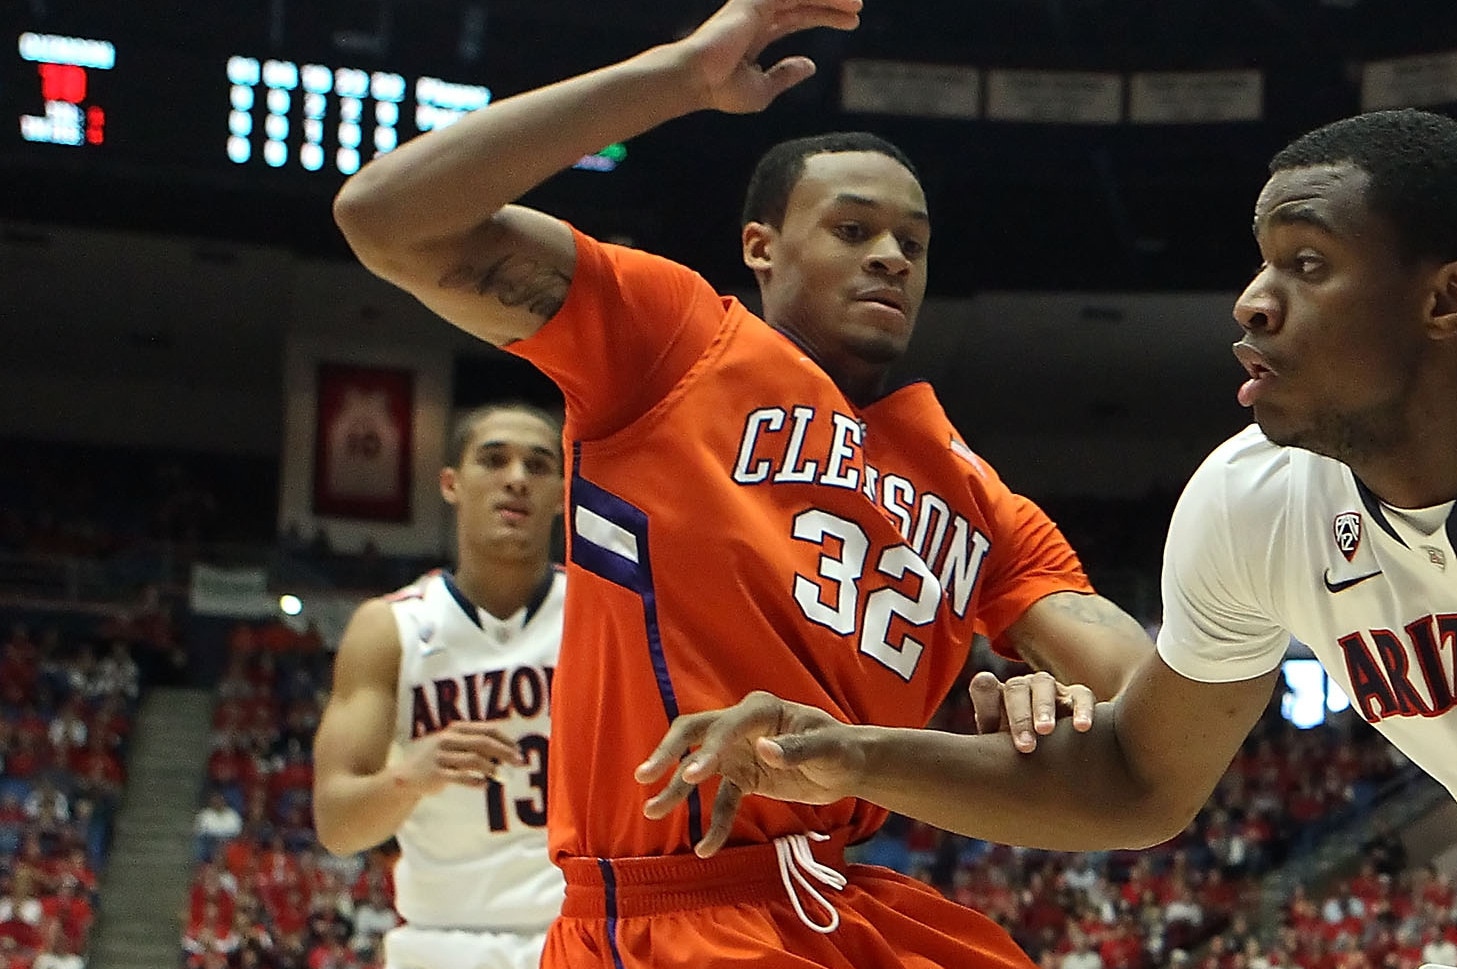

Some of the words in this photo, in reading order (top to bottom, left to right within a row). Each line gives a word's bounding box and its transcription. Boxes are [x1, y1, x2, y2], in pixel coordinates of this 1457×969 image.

[790, 508, 943, 683] 32
[411, 666, 556, 740] ARIZO
[485, 734, 550, 833] 13
